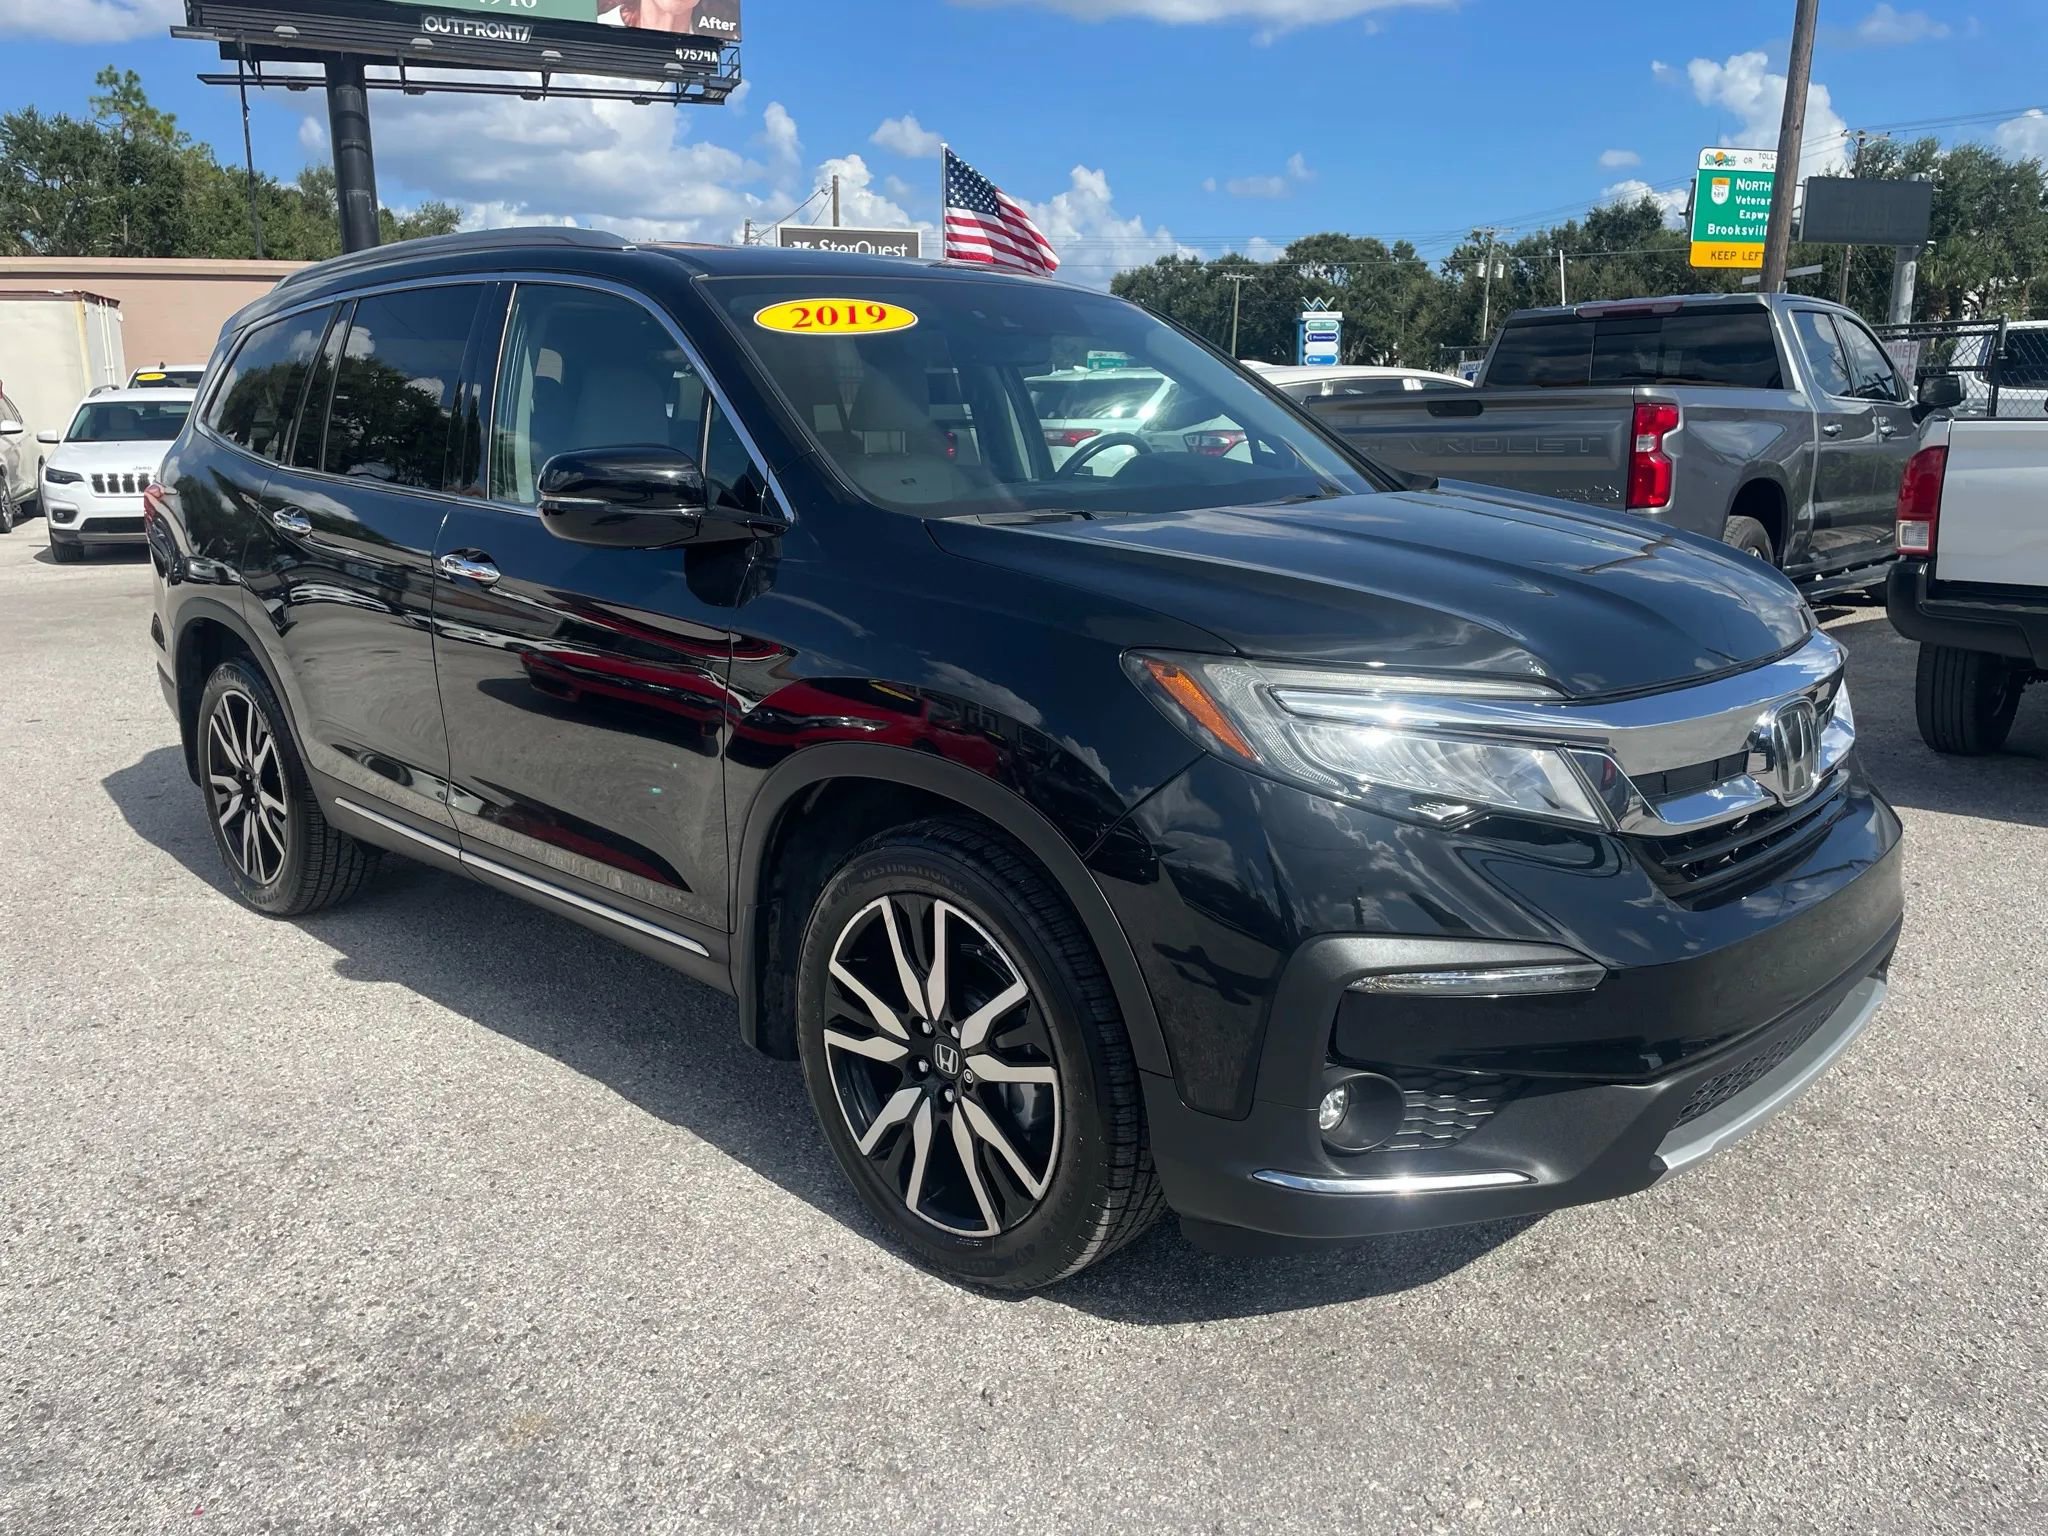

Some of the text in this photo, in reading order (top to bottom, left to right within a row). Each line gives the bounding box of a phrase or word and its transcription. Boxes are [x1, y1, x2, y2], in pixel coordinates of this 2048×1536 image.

[698, 16, 737, 32] After
[675, 48, 718, 62] 47574A
[1743, 157, 1754, 165] OR
[1761, 163, 1775, 171] PLA
[1735, 178, 1772, 192] NORTH
[1739, 209, 1770, 222] Expwy
[1707, 223, 1768, 237] Brooksvill
[819, 239, 908, 257] StorQuest
[1710, 250, 1737, 261] KEEP
[790, 305, 887, 328] 2019
